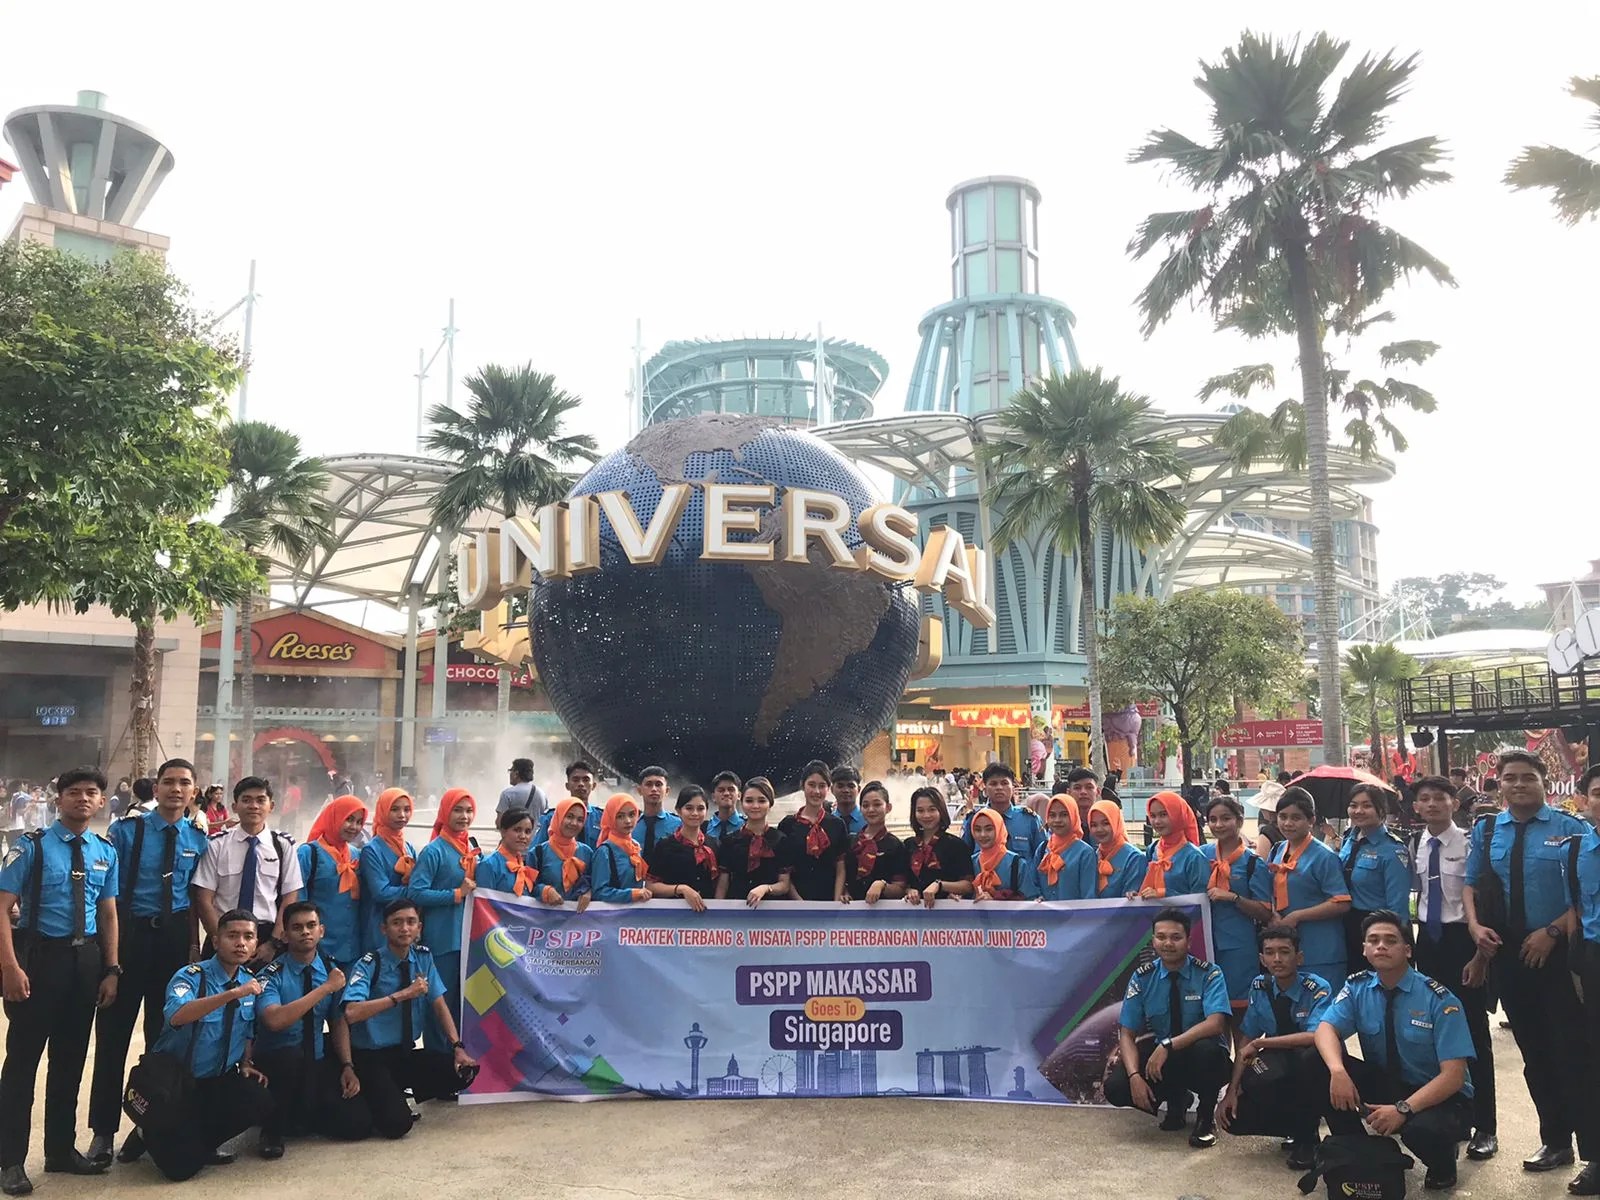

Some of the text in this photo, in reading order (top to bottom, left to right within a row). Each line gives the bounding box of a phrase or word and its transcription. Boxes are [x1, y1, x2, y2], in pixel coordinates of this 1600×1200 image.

[269, 633, 355, 661] Reese's
[446, 667, 528, 684] CHOCOE
[527, 927, 602, 949] PSPP
[619, 928, 1046, 947] PRAKTEK TERBANG & WISATA PSPP PENERBANGAN ANGKATAN JUNI 2023
[750, 968, 917, 997] PSPP MAKASSAR
[811, 1001, 857, 1016] Goes To
[784, 1016, 891, 1050] Singapore
